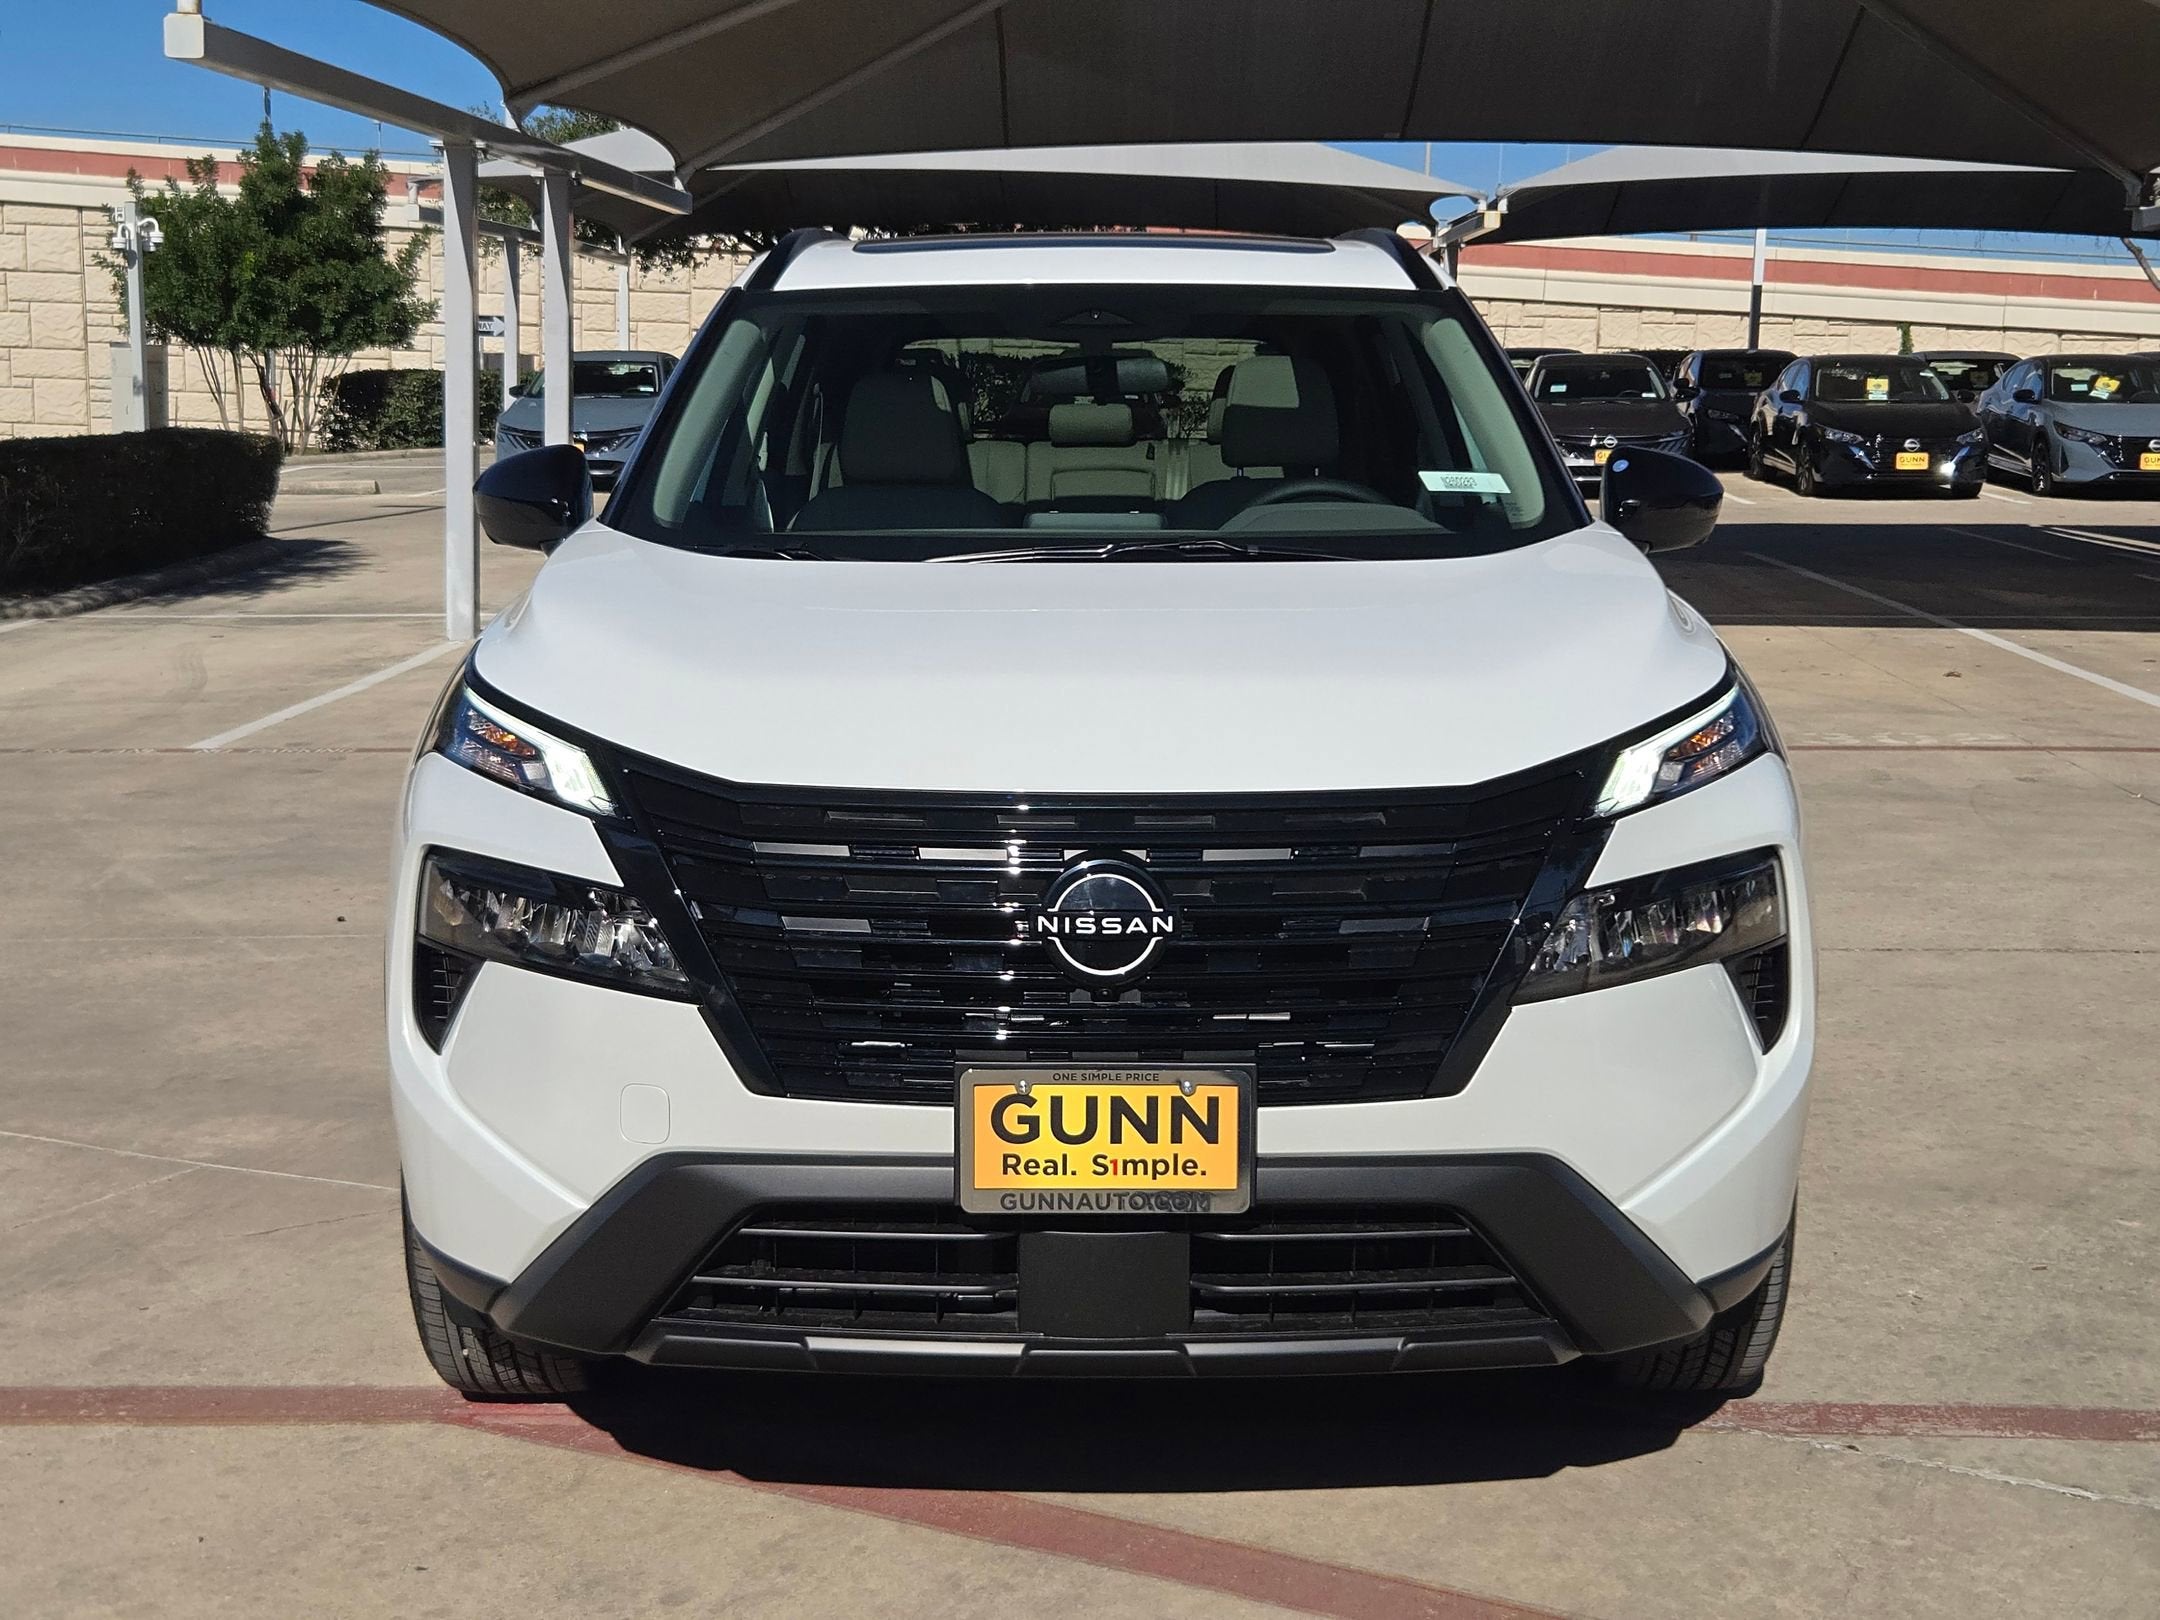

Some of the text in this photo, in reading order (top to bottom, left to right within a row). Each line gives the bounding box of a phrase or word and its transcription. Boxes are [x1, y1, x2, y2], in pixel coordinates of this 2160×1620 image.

[1037, 915, 1173, 934] NISSAN
[1052, 1072, 1160, 1082] ONE SIMPLE PRICE
[990, 1093, 1220, 1145] GUNN
[1002, 1153, 1077, 1176] Real.
[1000, 1191, 1212, 1211] GUNNAUTO.COM
